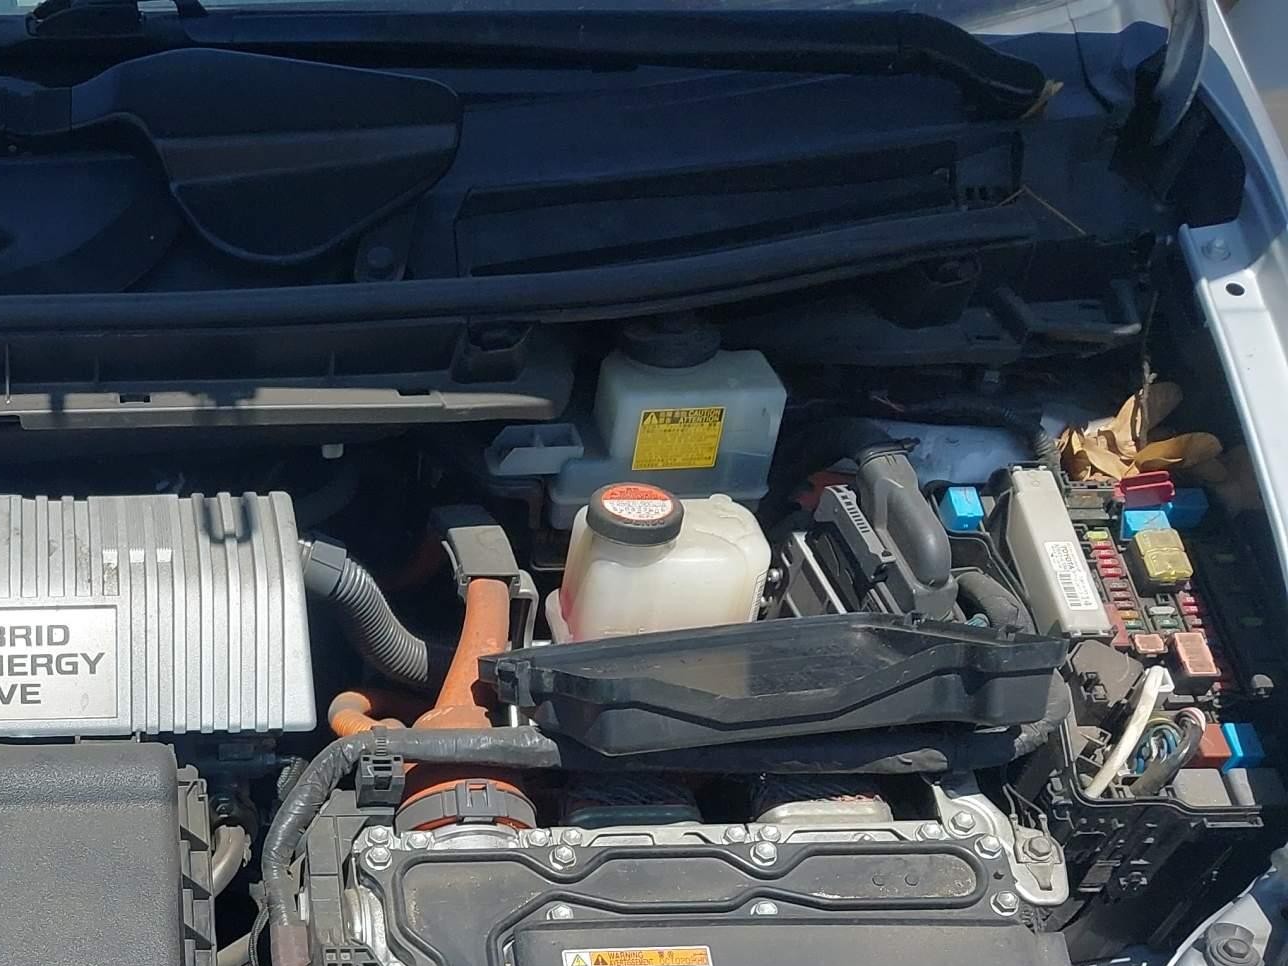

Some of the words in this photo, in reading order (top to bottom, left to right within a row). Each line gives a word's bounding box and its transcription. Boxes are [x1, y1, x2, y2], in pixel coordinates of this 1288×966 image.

[688, 408, 721, 417] CAUTION
[678, 416, 720, 424] ATTENTION
[608, 951, 644, 959] WARNING
